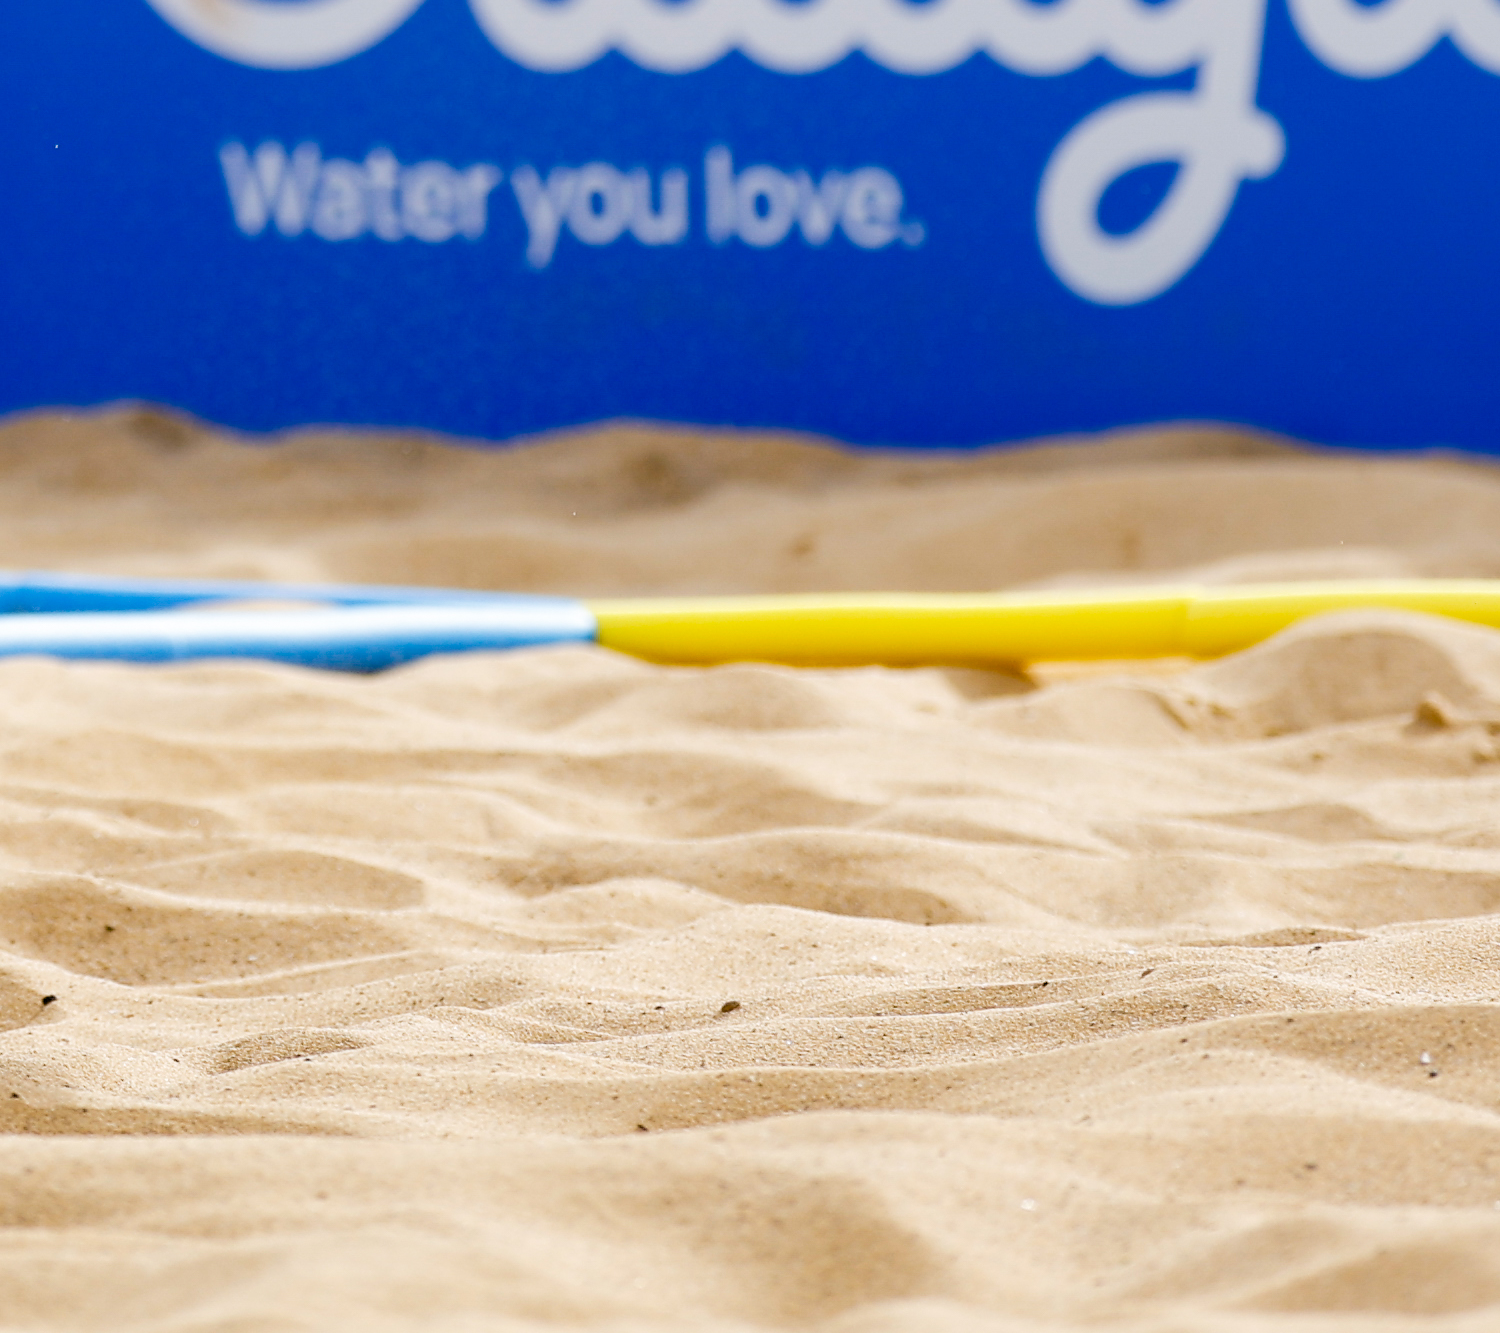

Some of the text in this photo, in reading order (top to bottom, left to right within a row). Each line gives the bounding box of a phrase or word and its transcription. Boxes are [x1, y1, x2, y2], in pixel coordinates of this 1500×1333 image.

[219, 141, 927, 270] Water you love.
